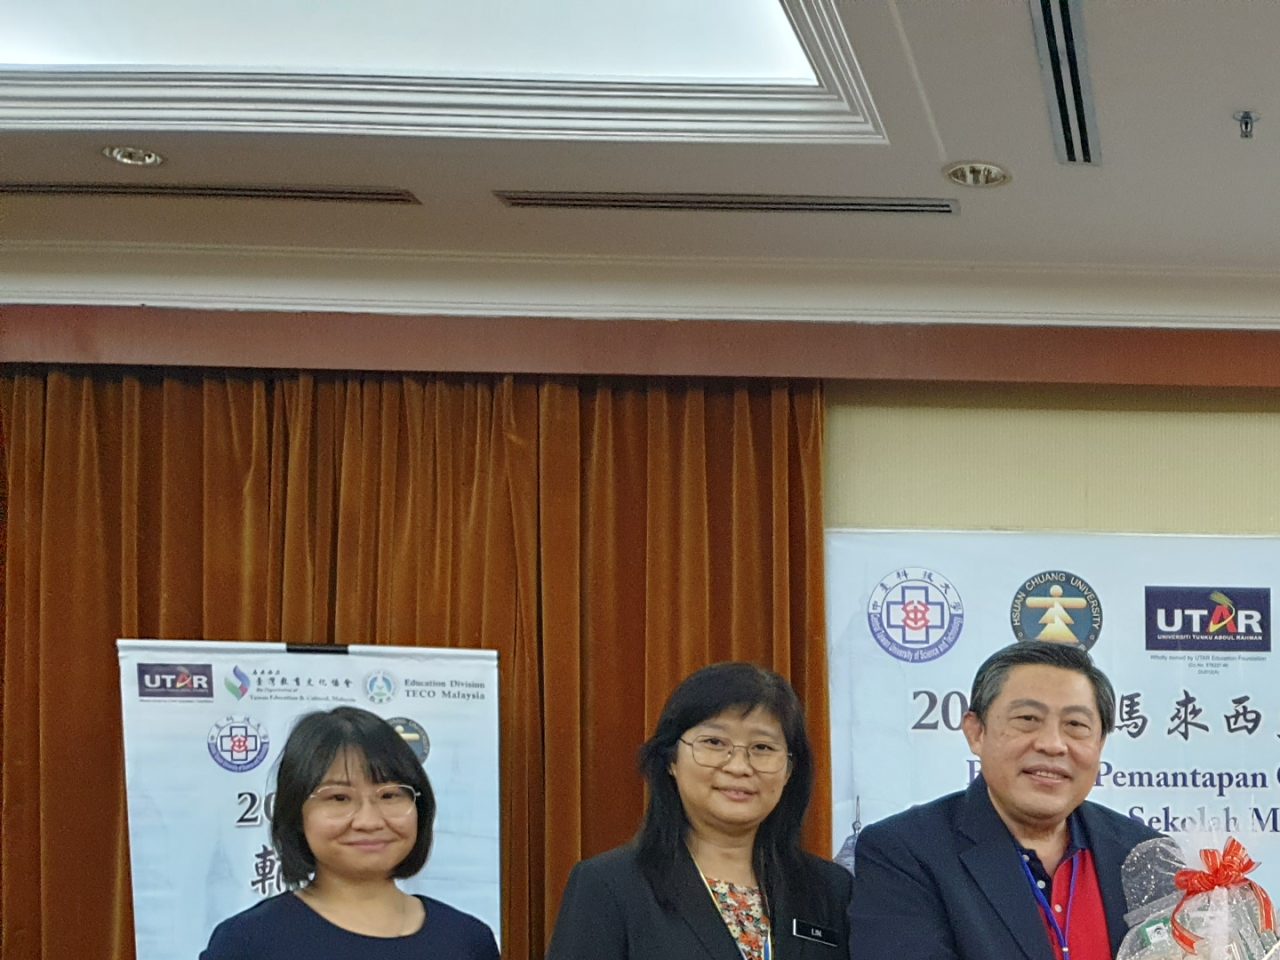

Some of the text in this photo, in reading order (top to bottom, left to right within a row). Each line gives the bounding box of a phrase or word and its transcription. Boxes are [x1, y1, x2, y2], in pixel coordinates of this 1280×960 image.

[1012, 572, 1101, 630] HSUAN CHUANG UNIVERSITY
[1156, 604, 1263, 633] UTAR
[144, 672, 208, 689] UTAR
[405, 689, 485, 701] TECO Malaysia
[1096, 762, 1268, 797] Pemantapan
